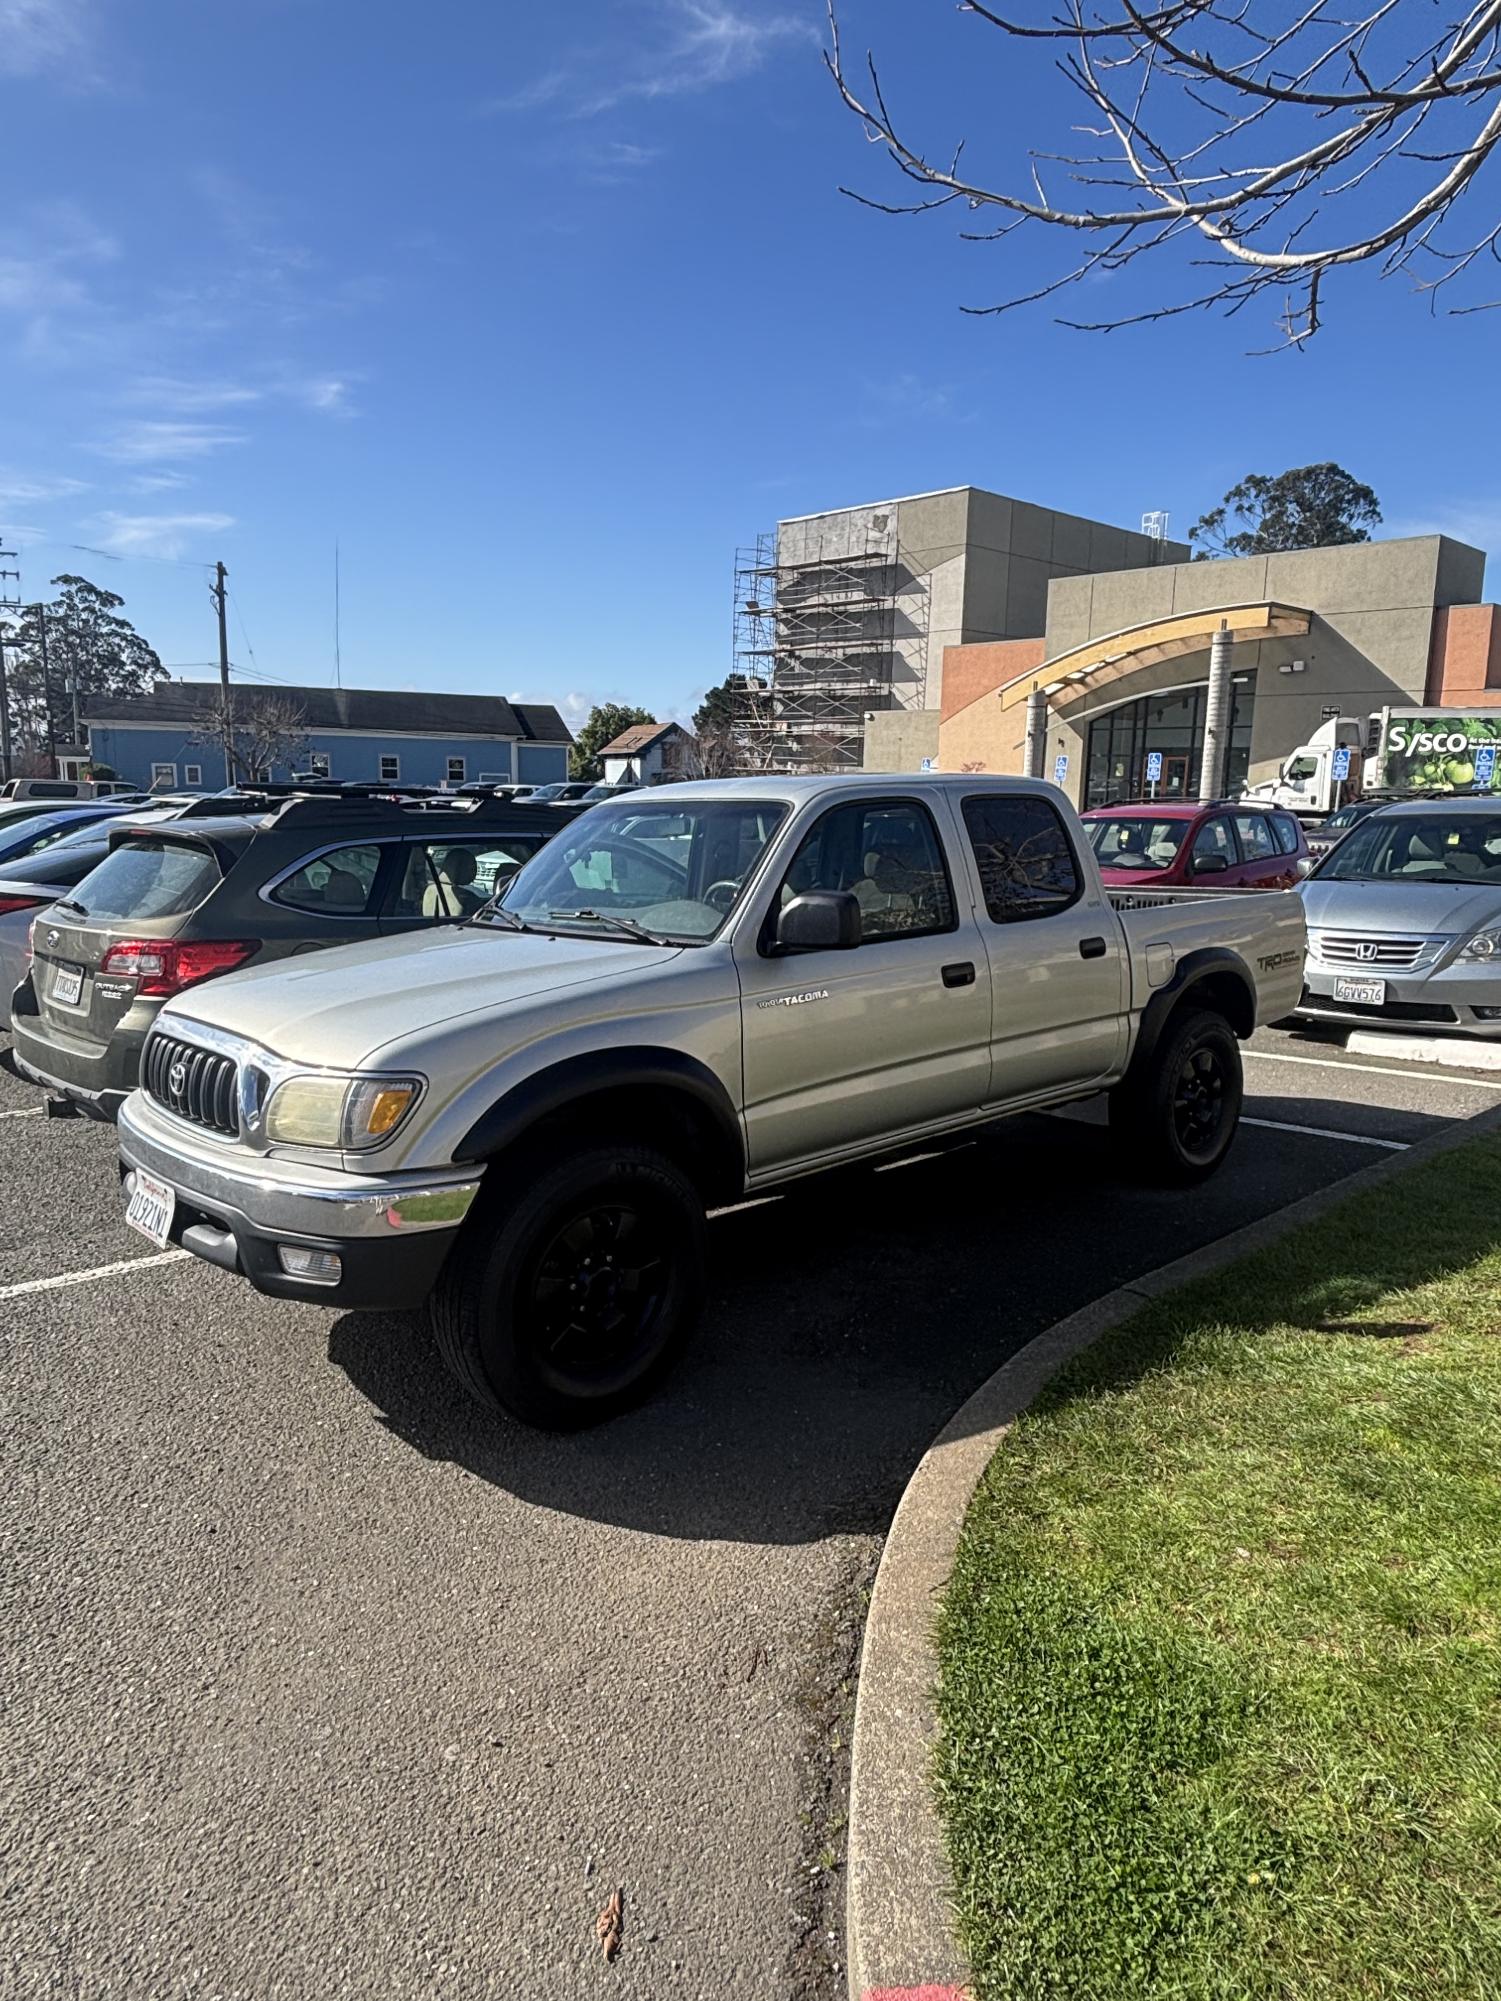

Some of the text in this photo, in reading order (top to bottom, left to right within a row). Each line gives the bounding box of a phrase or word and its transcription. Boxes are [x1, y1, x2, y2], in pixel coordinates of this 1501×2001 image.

[784, 989, 829, 1006] TACOMA
[1336, 985, 1382, 1001] 6GVV576
[129, 1191, 168, 1238] 01921N1
